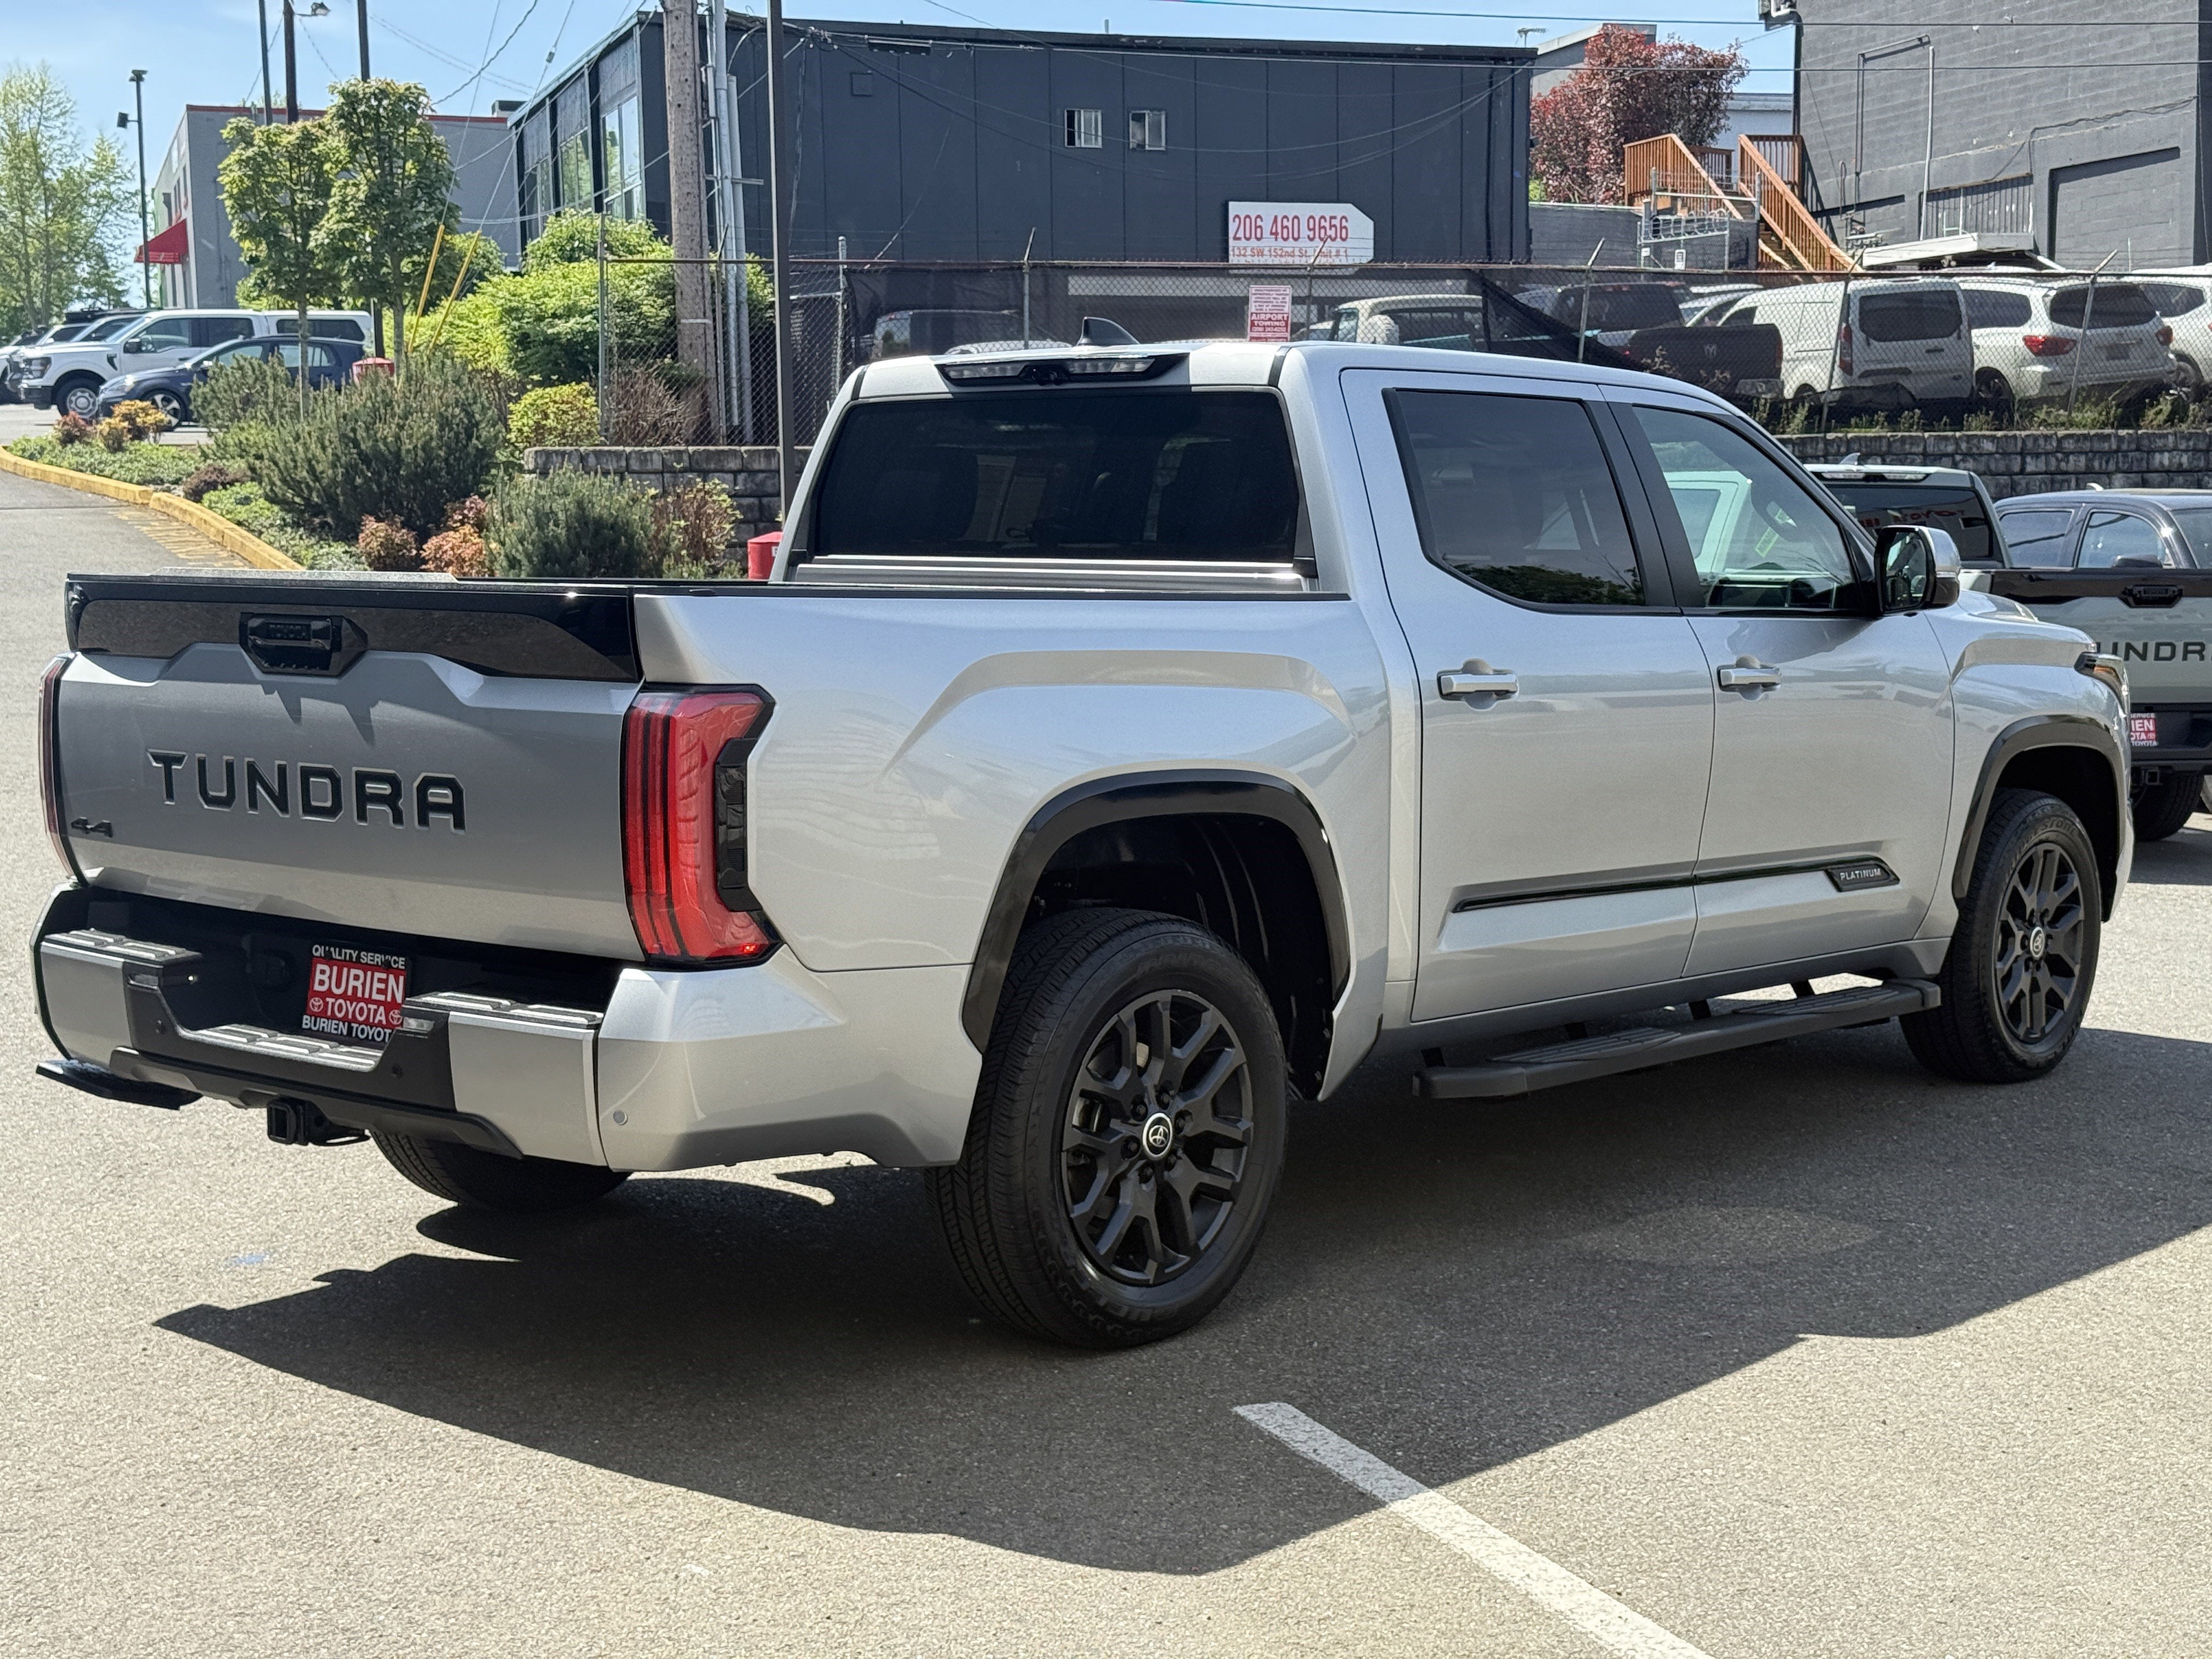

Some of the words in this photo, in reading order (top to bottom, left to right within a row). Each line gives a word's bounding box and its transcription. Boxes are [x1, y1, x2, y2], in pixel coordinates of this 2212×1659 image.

[1232, 215, 1263, 241] 206
[1269, 215, 1300, 242] 460
[1306, 215, 1348, 242] 9656
[1250, 247, 1265, 258] SW
[1268, 247, 1295, 258] 152nd
[2096, 641, 2212, 662] UNDR
[2131, 719, 2154, 732] IEN
[147, 749, 466, 834] TUNDRA
[1839, 868, 1881, 881] PLATINUM
[313, 963, 404, 1004] BURIEN
[326, 997, 387, 1025] TOYOTA
[302, 1015, 348, 1036] BURIEN
[351, 1023, 392, 1042] TOYOT
